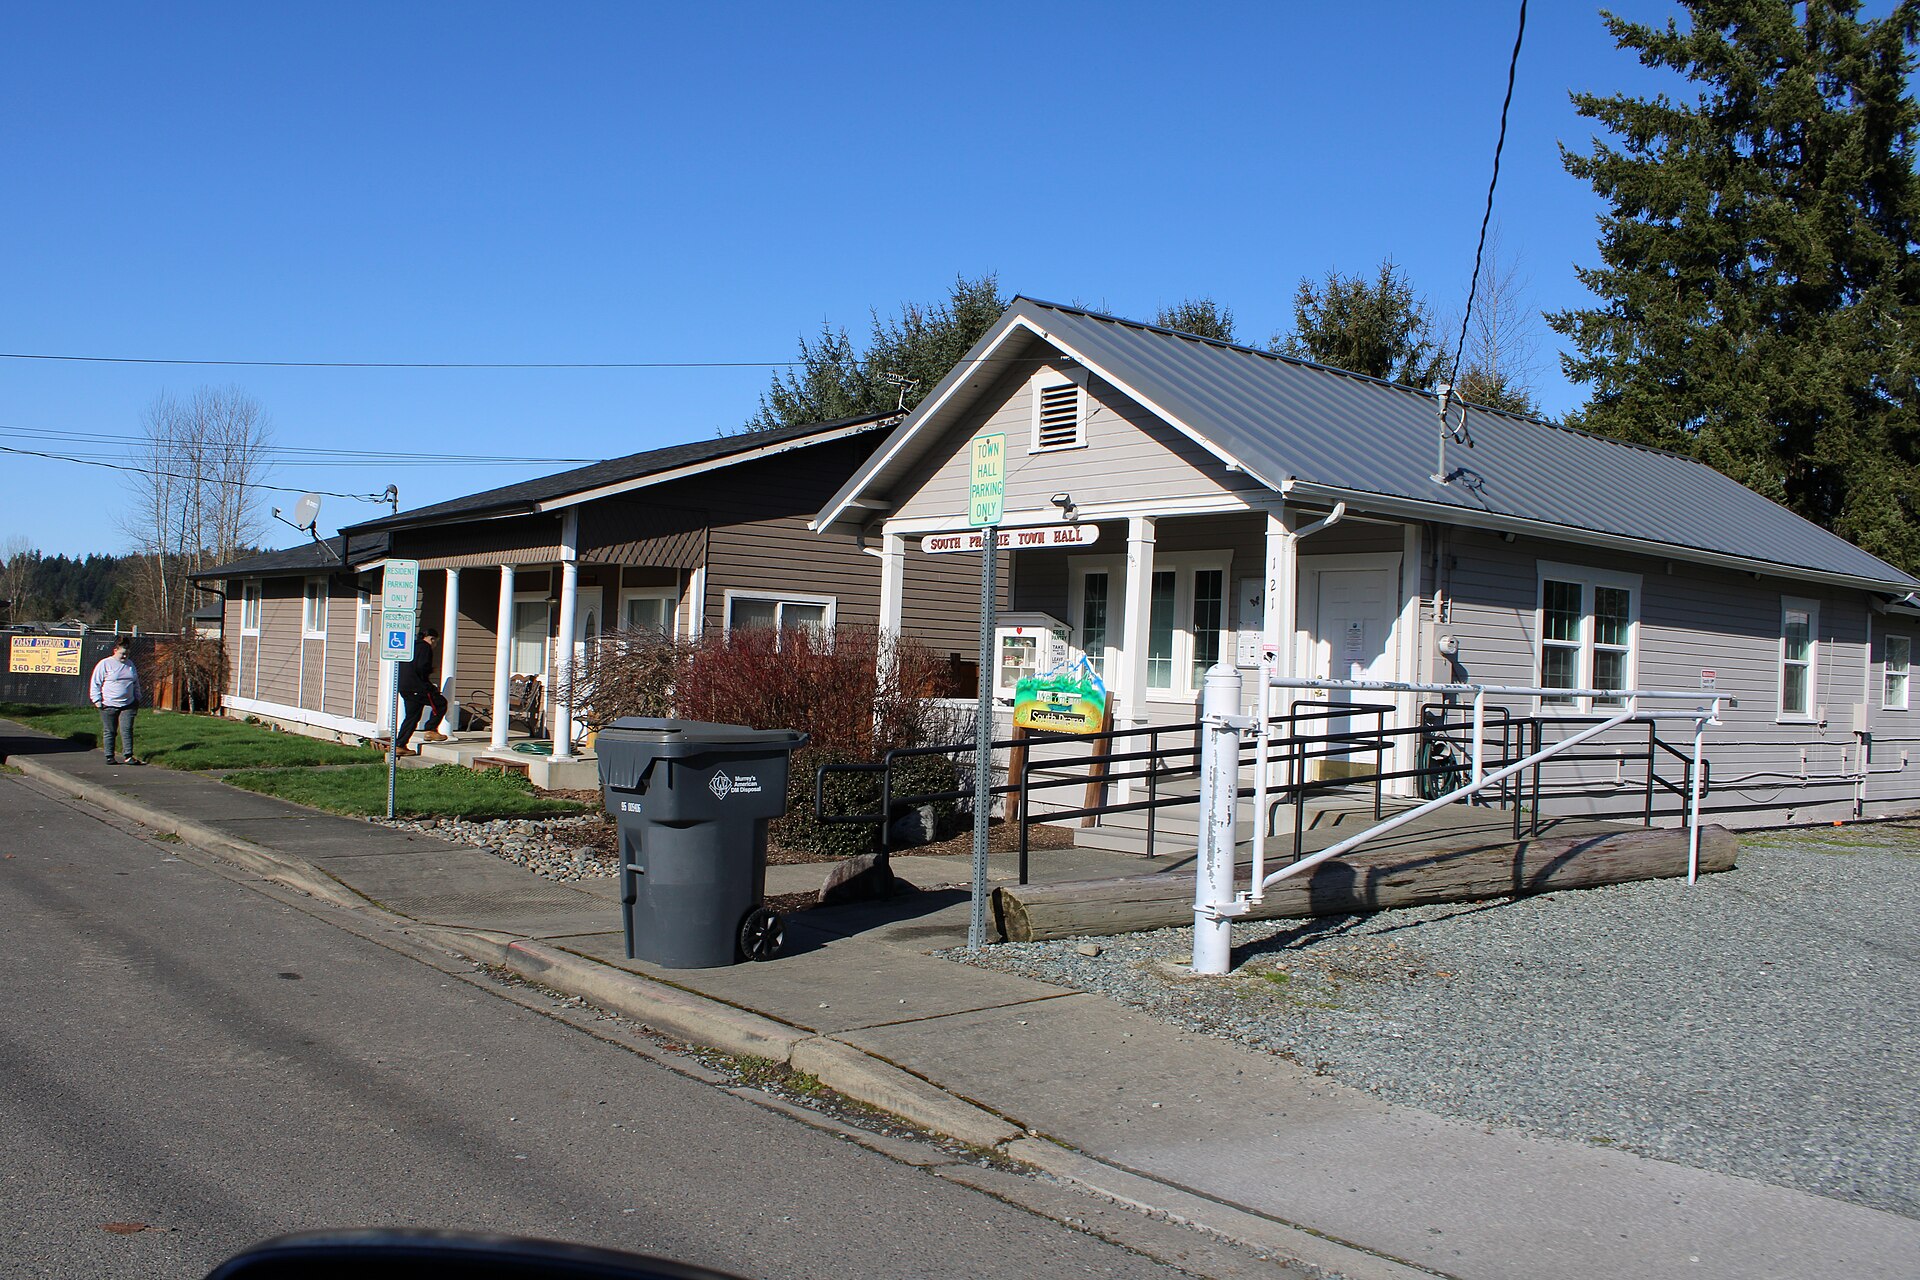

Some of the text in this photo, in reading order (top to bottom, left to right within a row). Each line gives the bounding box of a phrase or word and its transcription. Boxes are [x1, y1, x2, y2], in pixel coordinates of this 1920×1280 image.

[978, 442, 999, 458] TOWN
[977, 462, 997, 478] HALL
[971, 481, 1003, 498] PARKING
[976, 502, 997, 517] ONLY
[931, 537, 961, 550] SOUTH
[1017, 531, 1045, 545] TOWN
[1053, 529, 1083, 543] HALL
[386, 567, 415, 576] RESIDENT
[387, 580, 414, 589] PARKING
[391, 594, 408, 602] ONLY
[385, 613, 412, 621] RESERVED
[385, 622, 411, 630] PARKING
[13, 638, 32, 647] COAST
[12, 664, 78, 673] 360-897-8625
[1032, 711, 1056, 723] South
[740, 786, 762, 794] Disposal
